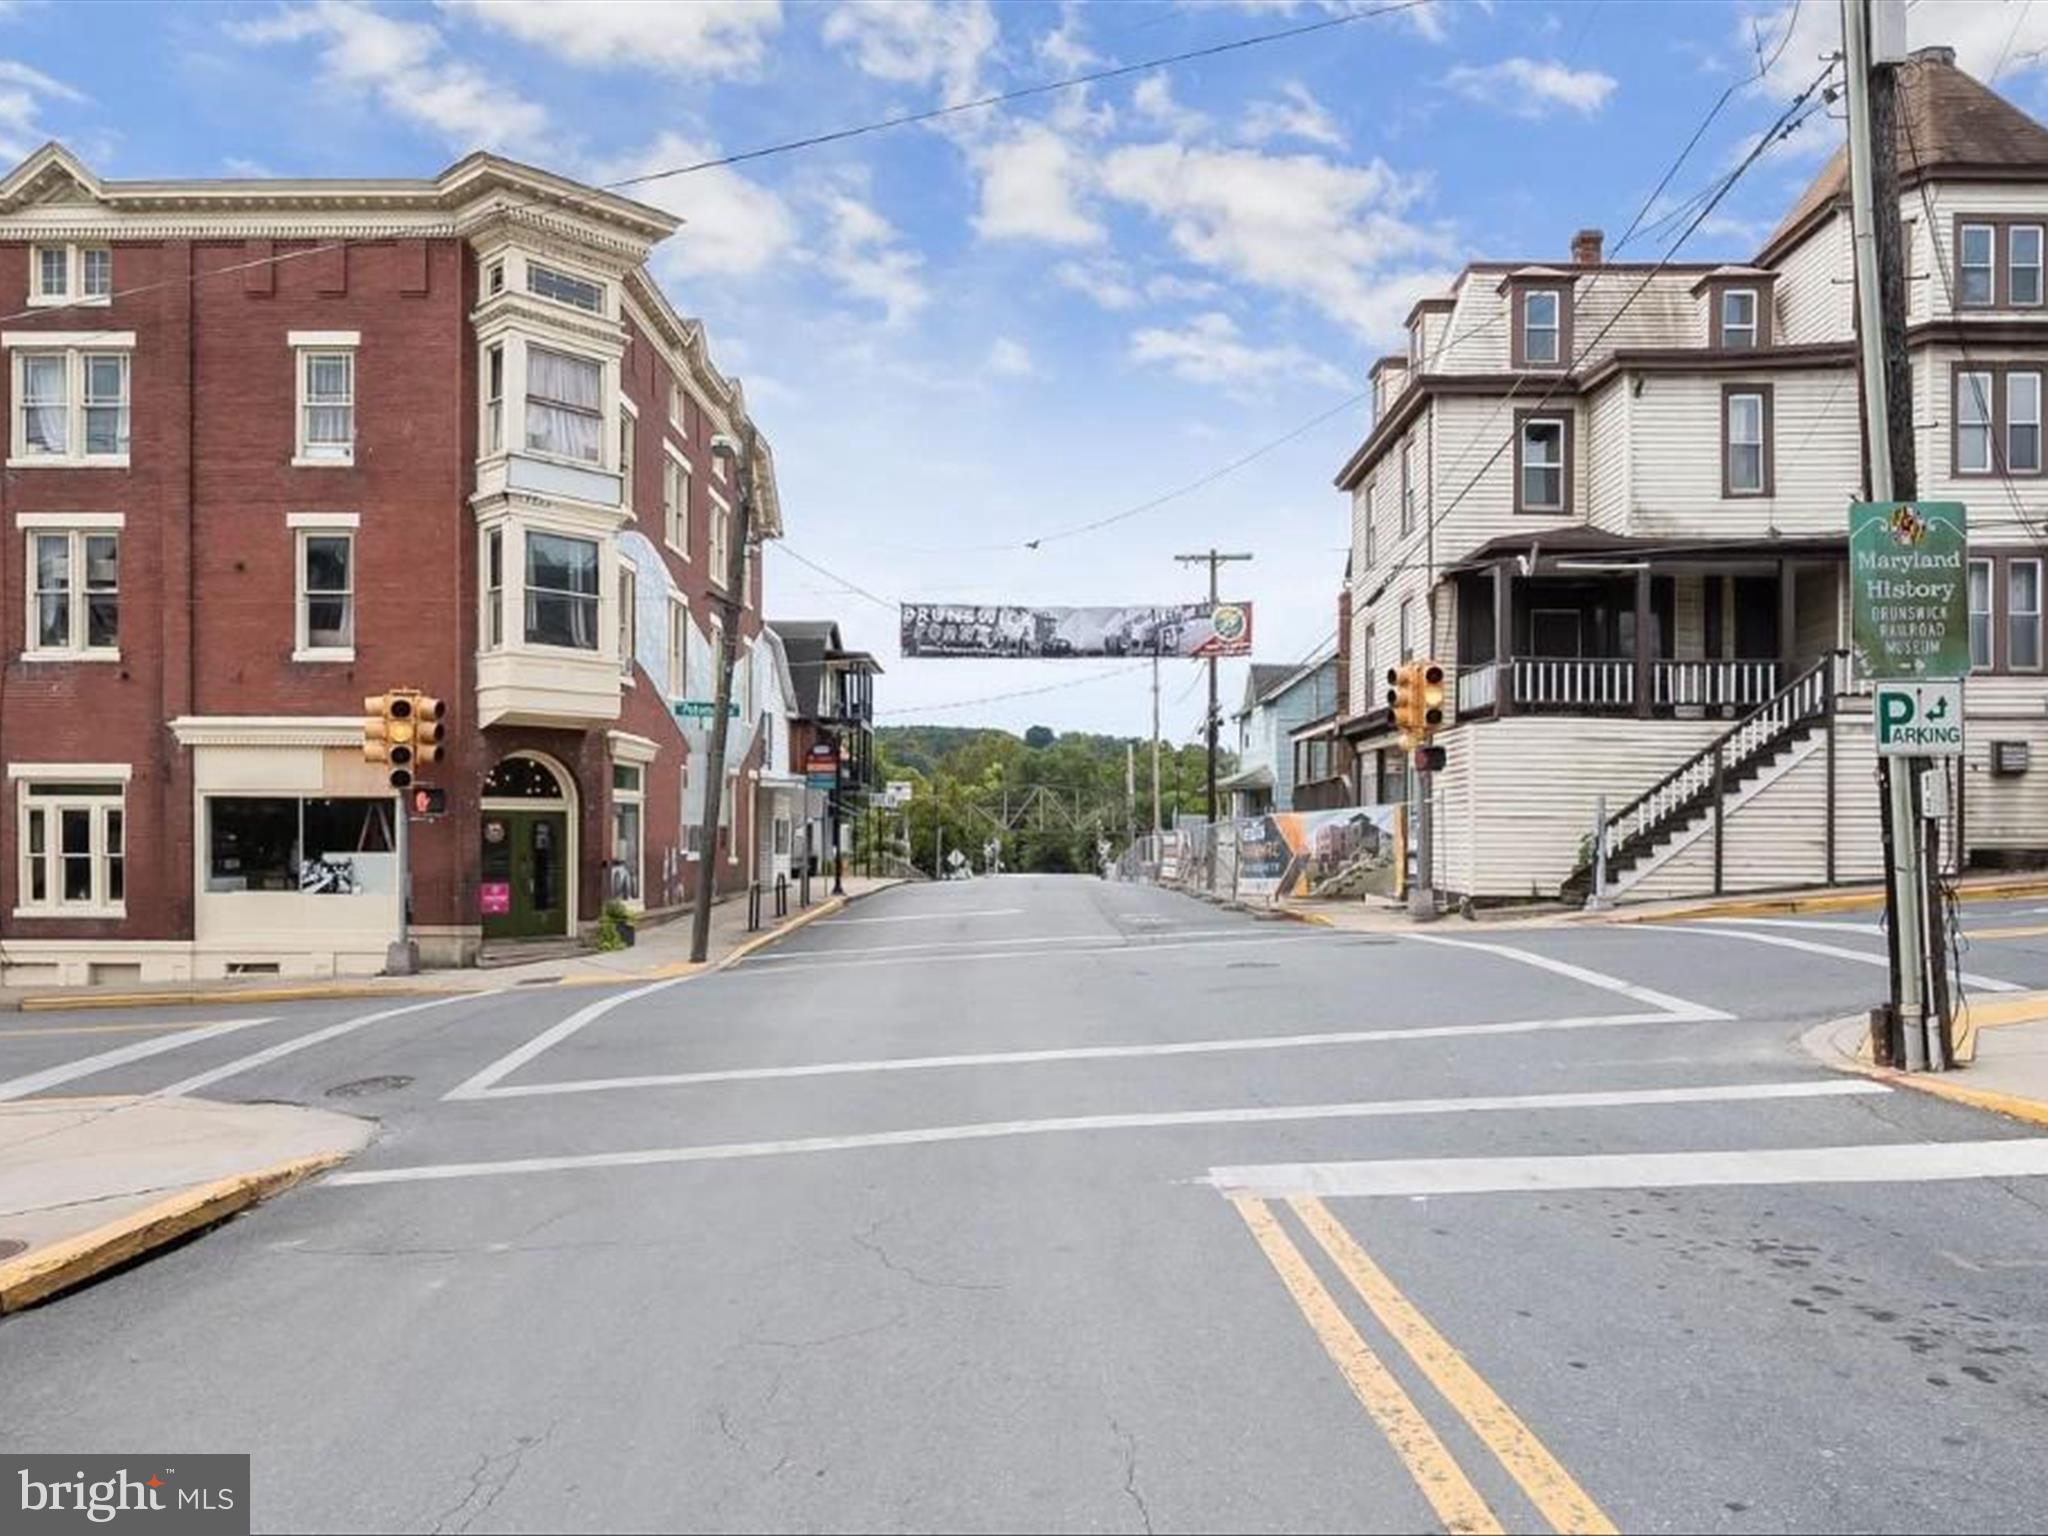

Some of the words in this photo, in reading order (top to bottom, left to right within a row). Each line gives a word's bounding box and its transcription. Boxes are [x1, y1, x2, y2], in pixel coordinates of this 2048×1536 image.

[1858, 551, 1961, 574] Maryland
[1867, 579, 1956, 601] History
[1871, 606, 1948, 621] BRUNSWICK
[1879, 622, 1946, 638] RAILROAD
[1885, 639, 1941, 655] MUSEUM
[1879, 692, 1961, 744] PARKING
